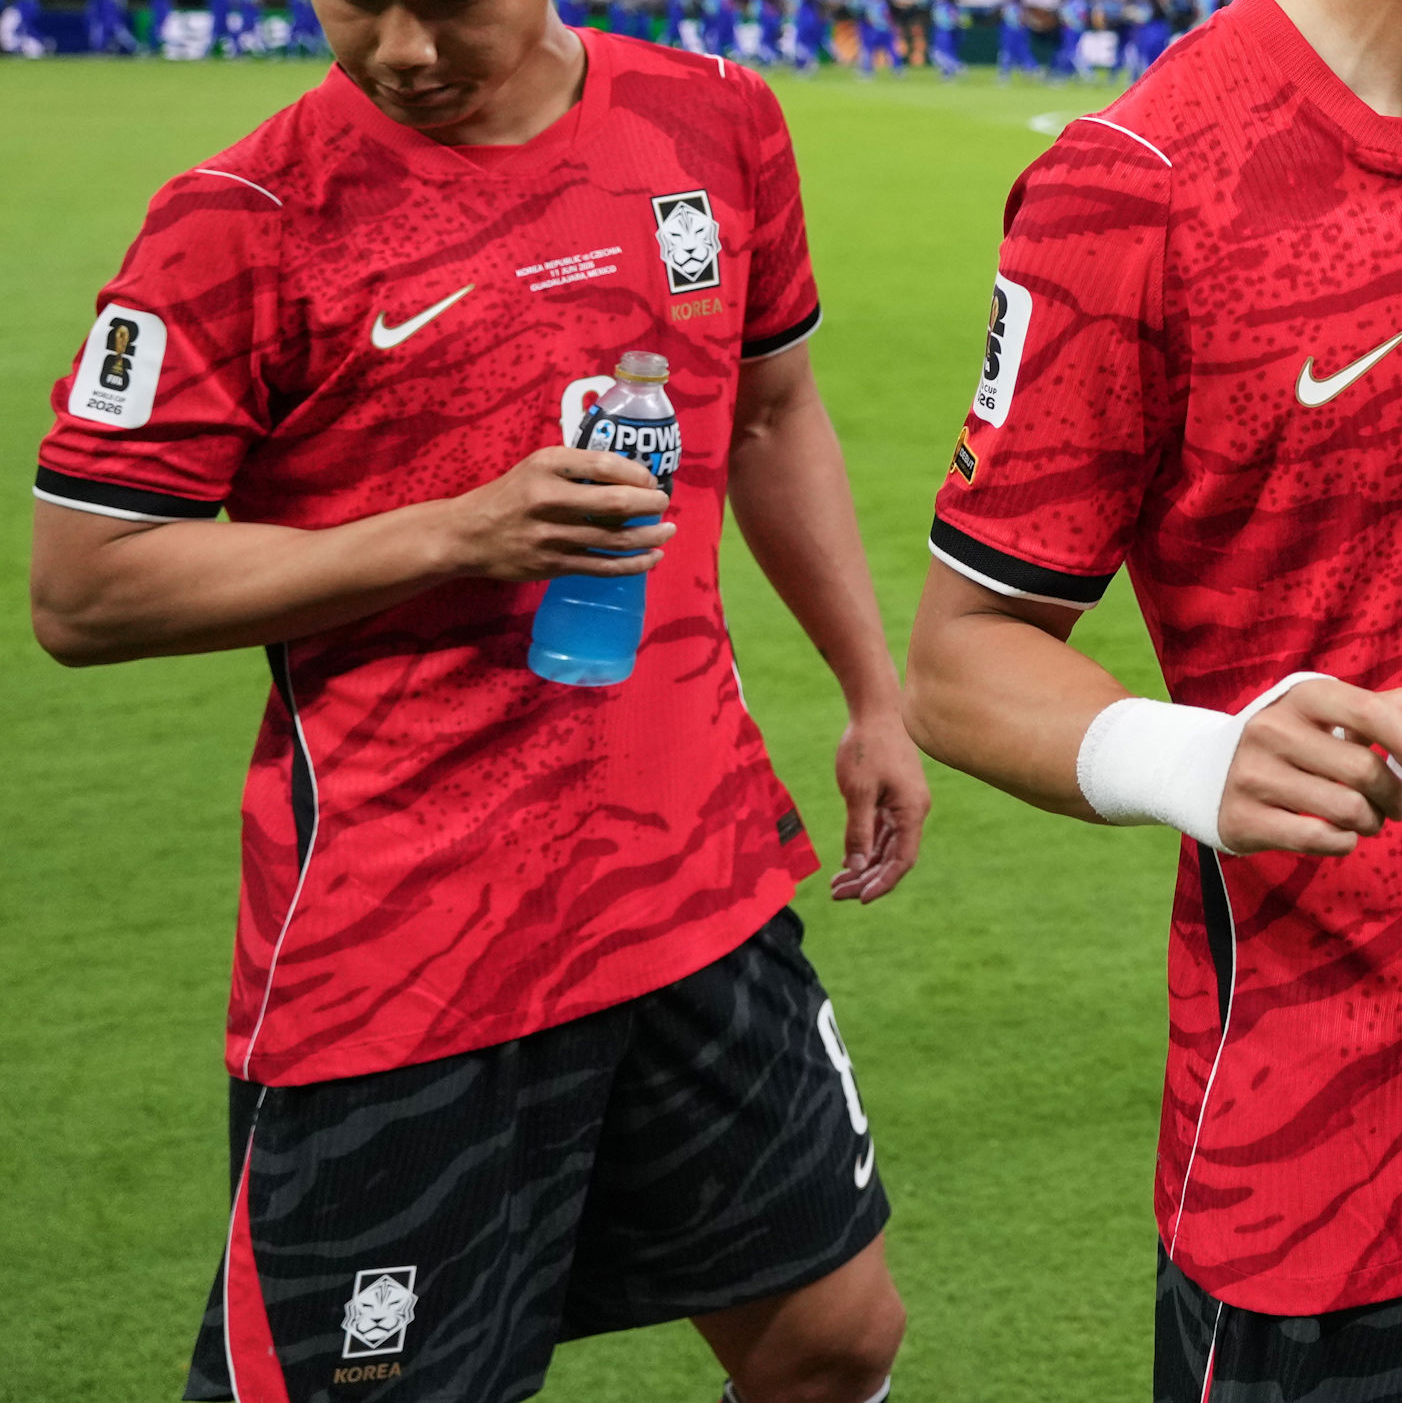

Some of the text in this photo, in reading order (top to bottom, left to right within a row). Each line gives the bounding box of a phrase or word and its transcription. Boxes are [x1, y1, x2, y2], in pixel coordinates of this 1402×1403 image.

[516, 263, 544, 278] KOREA
[544, 254, 582, 270] REPUBLIC
[589, 246, 623, 260] CZECHIA
[671, 298, 723, 322] KOREA
[86, 398, 123, 415] 2026
[959, 447, 975, 470] DEBUT
[333, 1361, 402, 1385] KOREA
